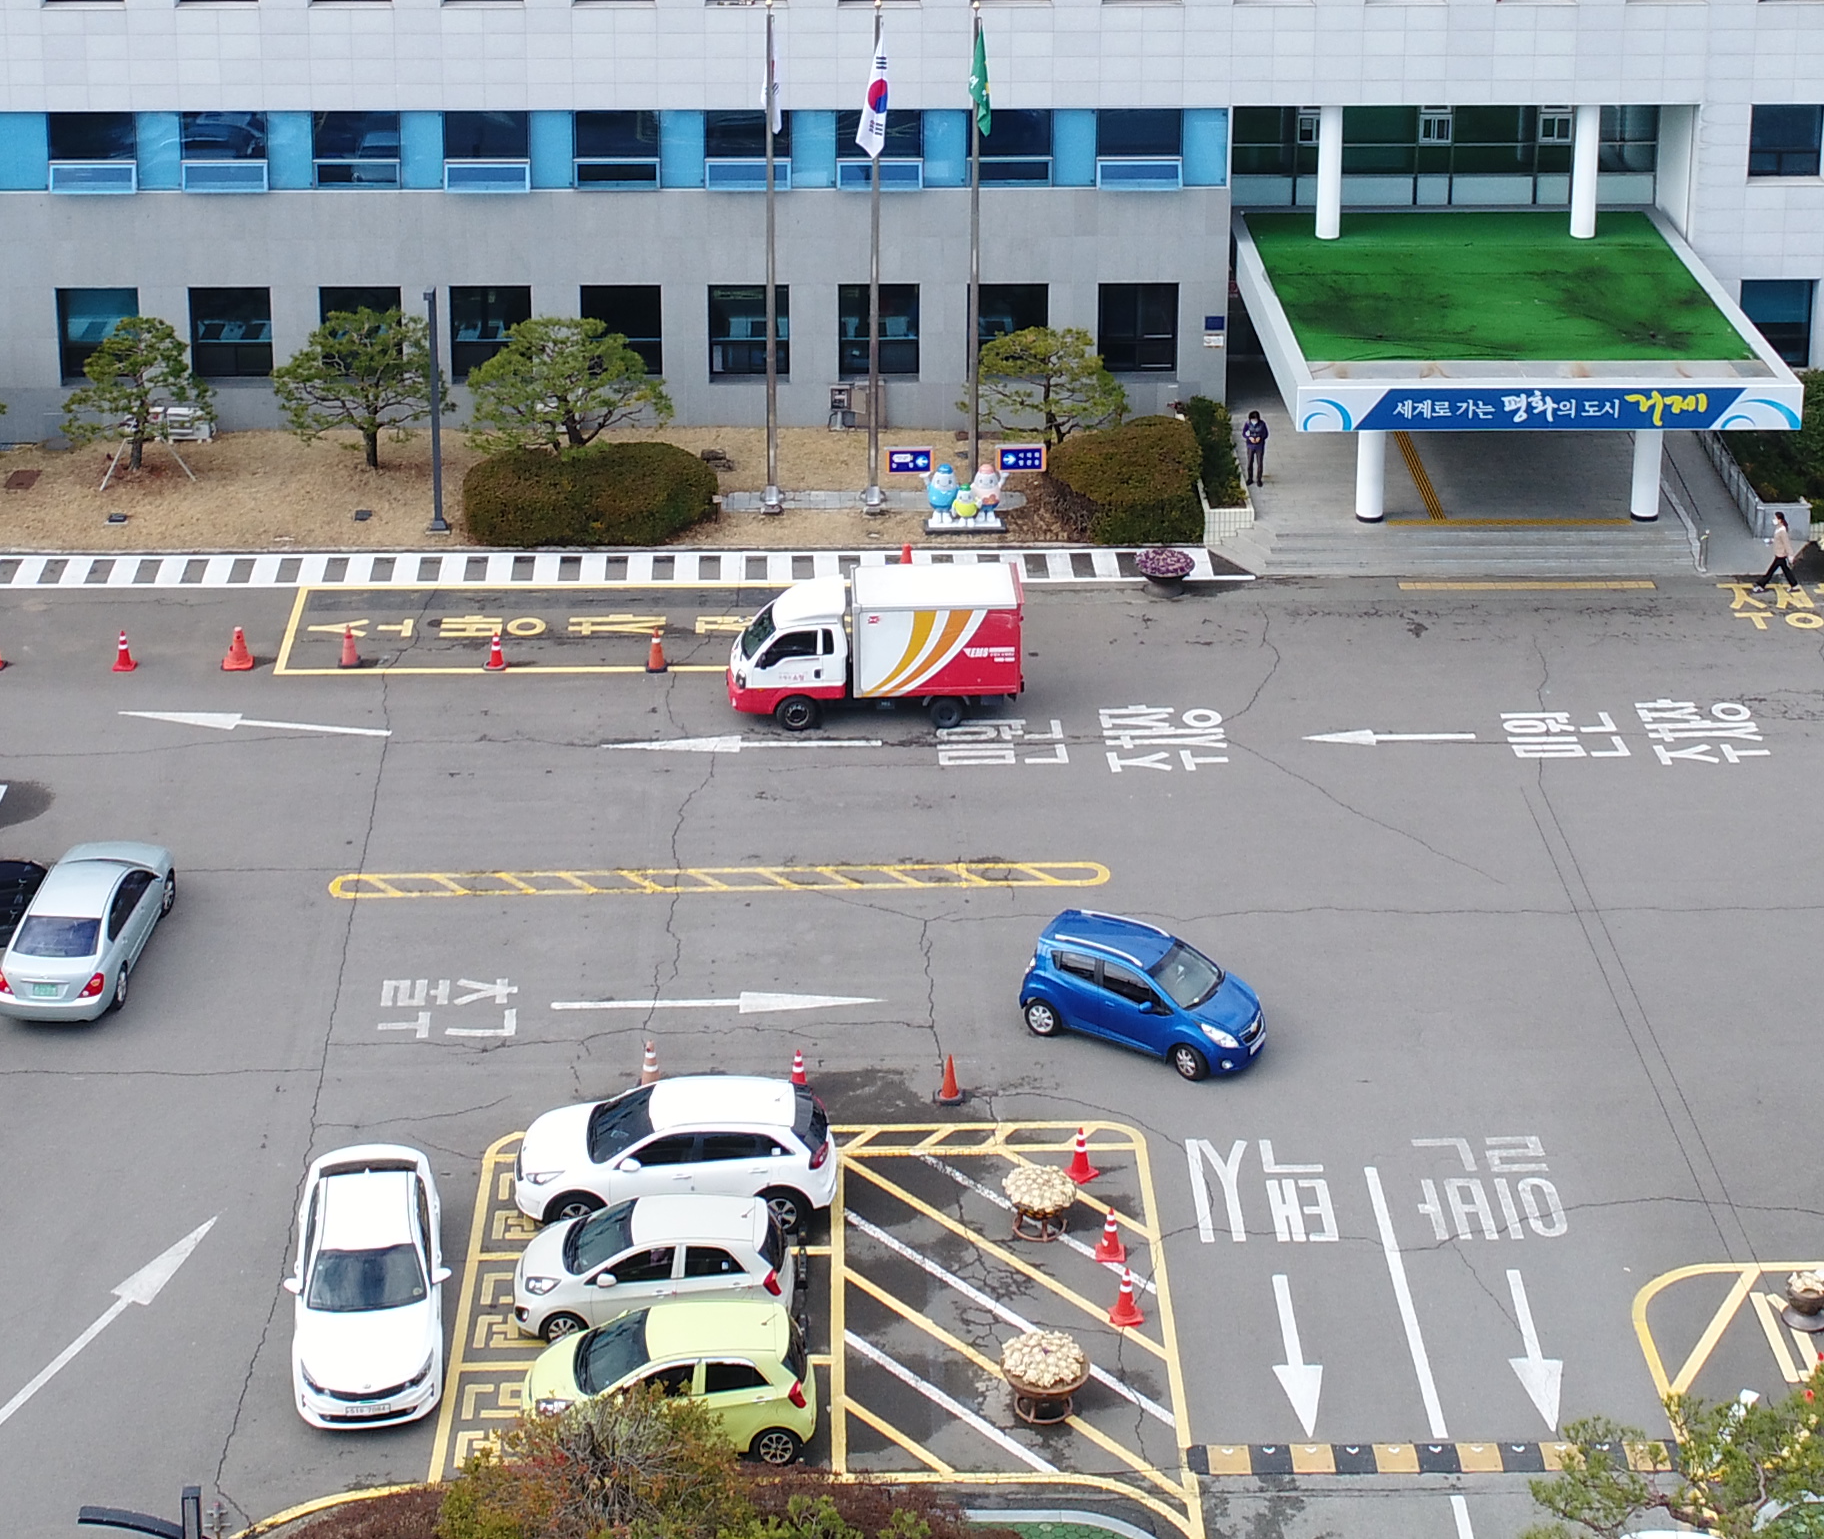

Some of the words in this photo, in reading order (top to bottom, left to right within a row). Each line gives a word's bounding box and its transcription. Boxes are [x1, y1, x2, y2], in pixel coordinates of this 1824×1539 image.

[1393, 400, 1452, 419] 세계로
[1455, 400, 1496, 419] 가는
[1500, 390, 1577, 423] 평화의
[1580, 400, 1621, 419] 도시
[1625, 390, 1708, 426] 거제
[969, 647, 989, 659] EMS
[377, 977, 519, 1039] 출구
[1184, 1138, 1340, 1244] 택시
[1410, 1135, 1570, 1242] 일반
